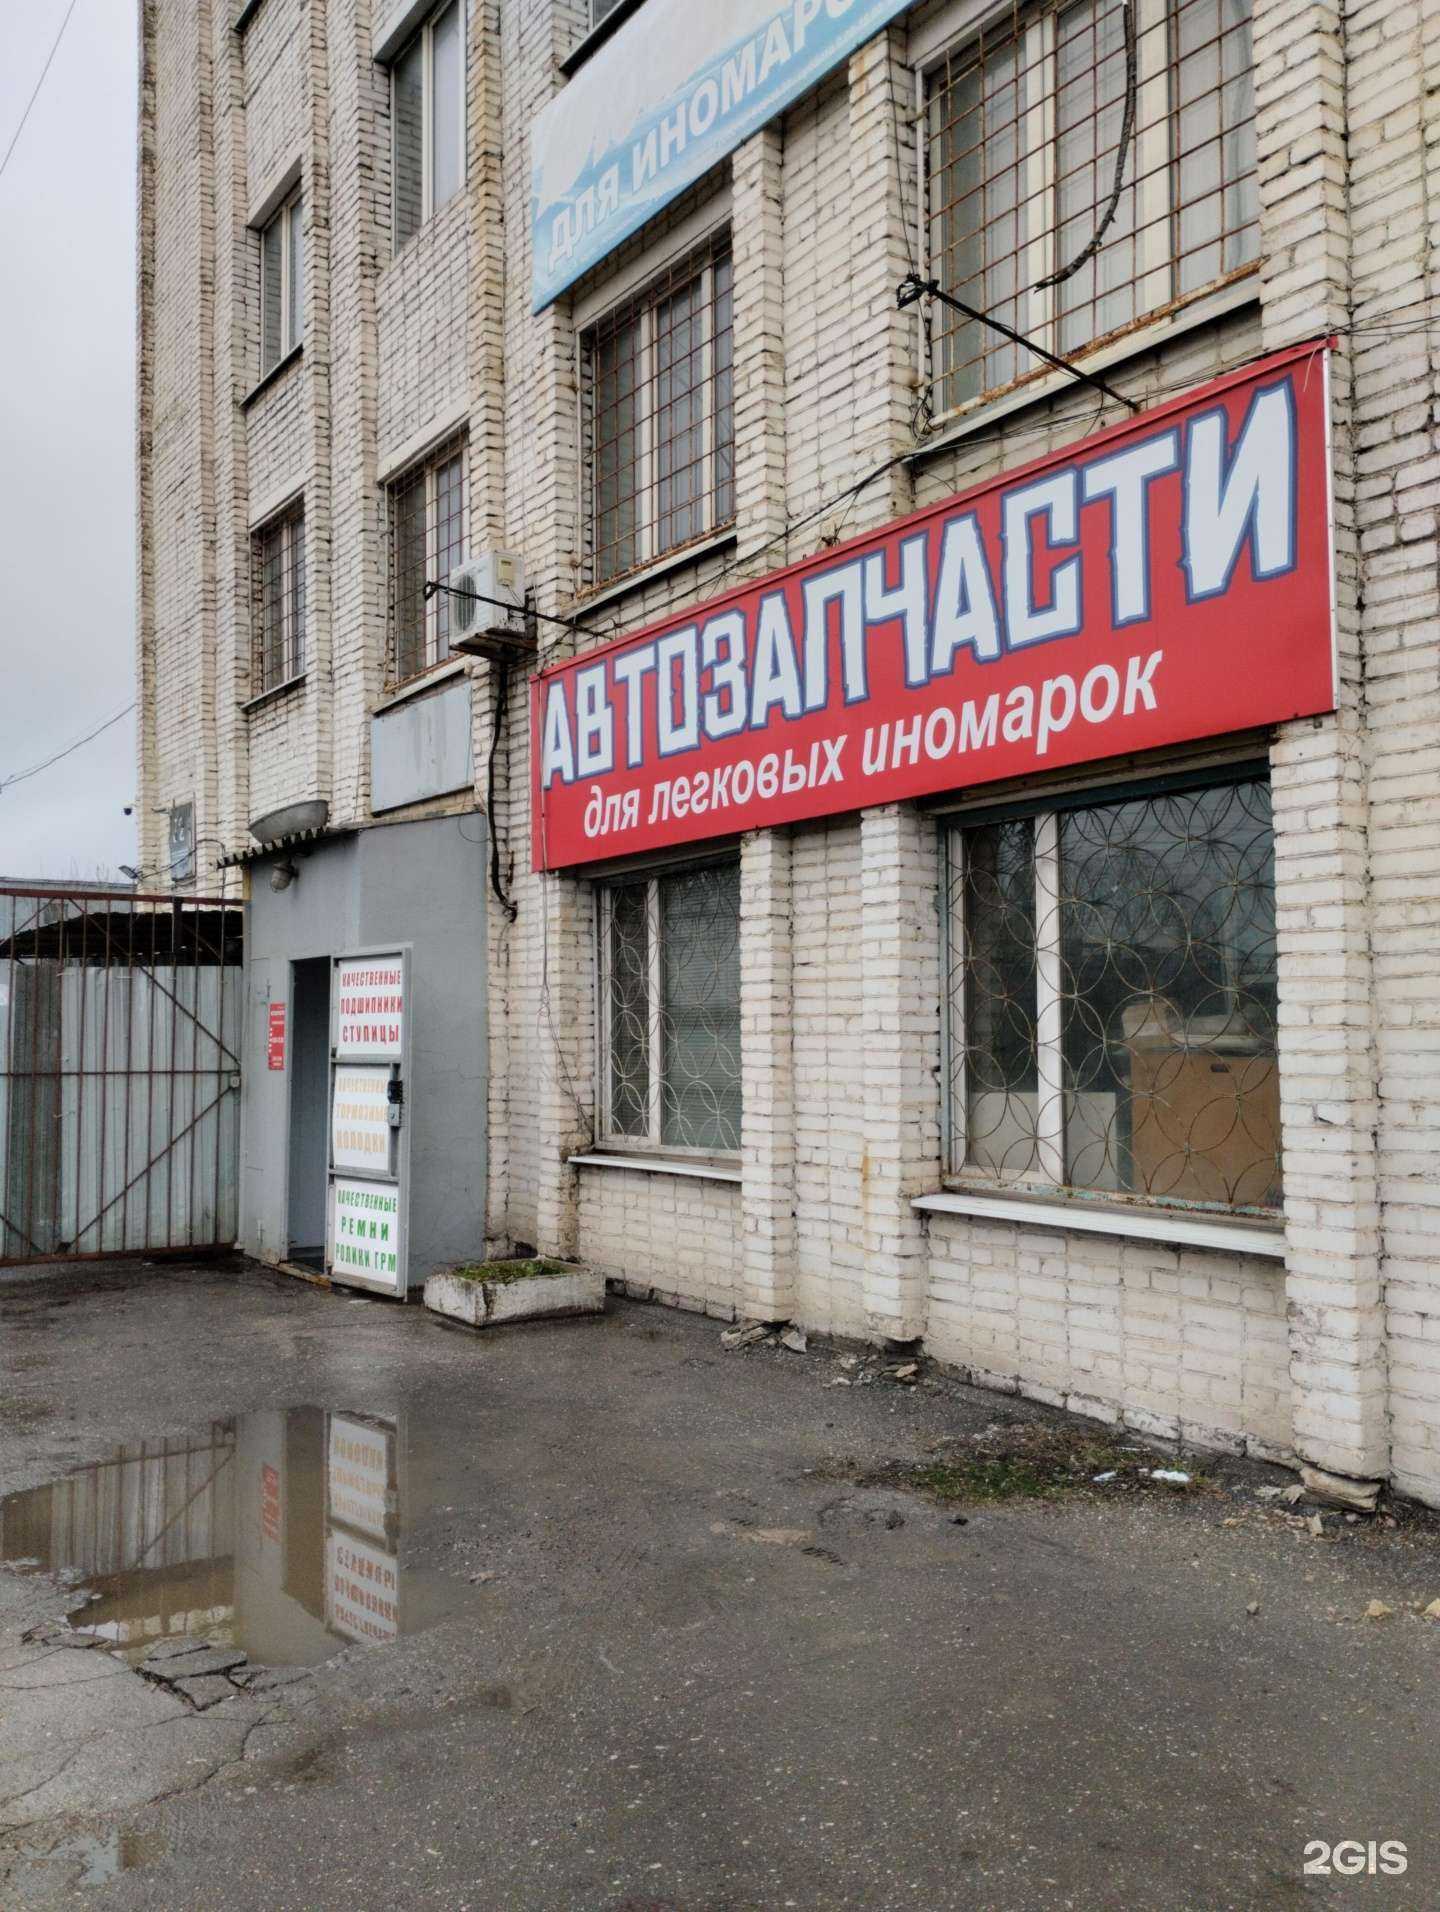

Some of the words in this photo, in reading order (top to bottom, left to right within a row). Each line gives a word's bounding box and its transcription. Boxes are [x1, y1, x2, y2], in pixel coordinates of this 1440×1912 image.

[547, 163, 619, 276] ДЛЯ
[542, 375, 1298, 789] АВТОЗАПЧАСТИ
[584, 785, 640, 838] для
[648, 735, 848, 825] легковых
[862, 650, 1163, 775] иномарок
[342, 970, 401, 987] КАЧЕСТВЕННЫЕ
[340, 996, 403, 1016] ПОДШИПНИКИ
[342, 1024, 400, 1045] СТУПИЦЫ
[337, 1189, 397, 1213] КАЧЕСТВЕННЫЕ
[341, 1215, 389, 1241] РЕМНИ
[374, 1250, 397, 1273] ГРМ
